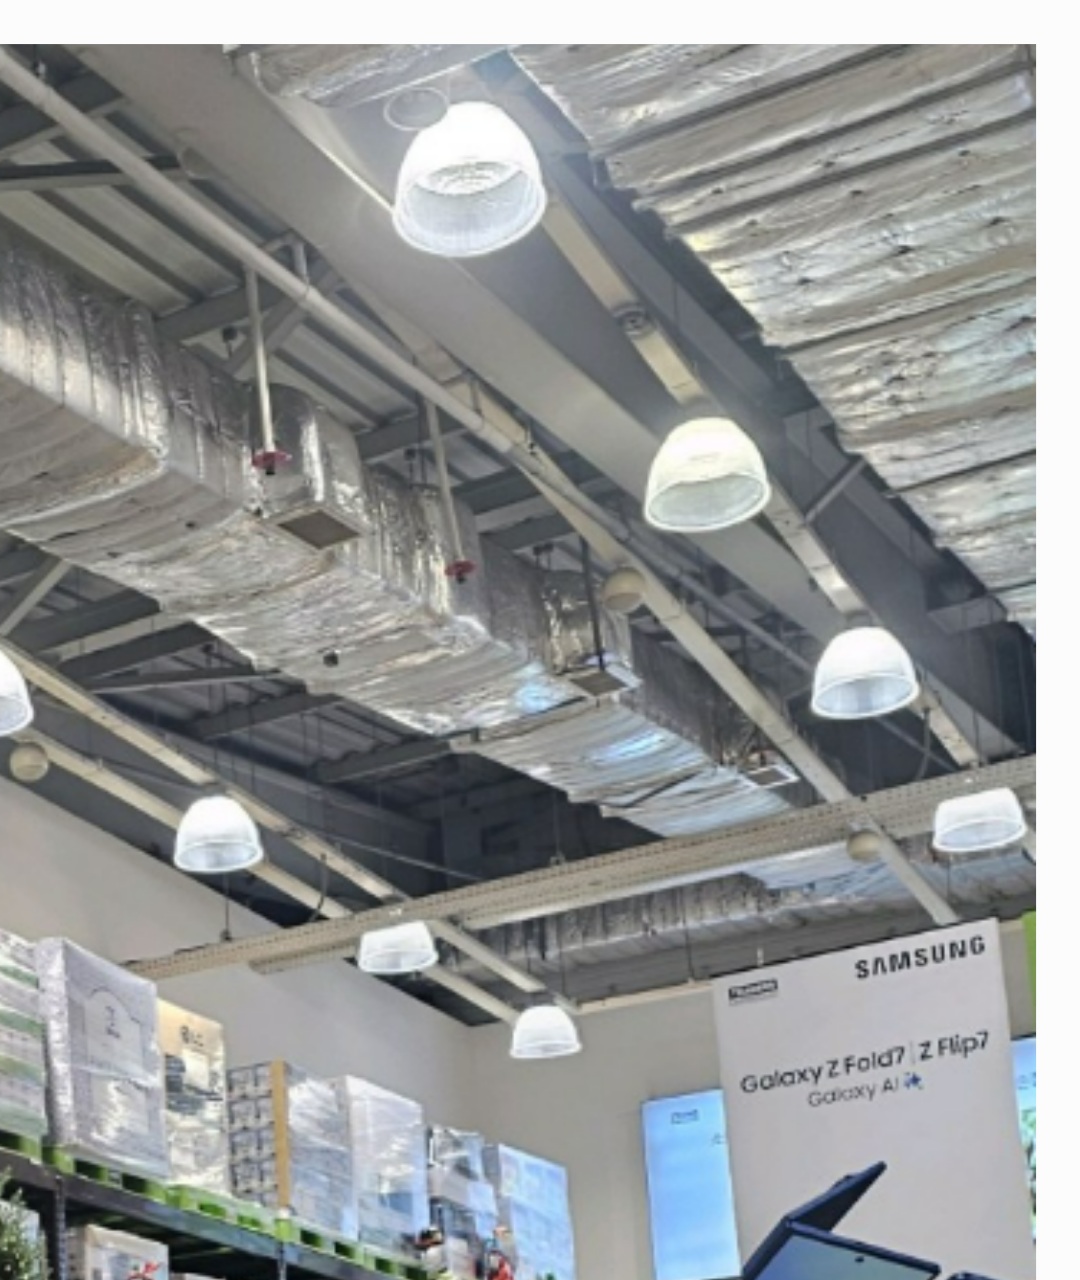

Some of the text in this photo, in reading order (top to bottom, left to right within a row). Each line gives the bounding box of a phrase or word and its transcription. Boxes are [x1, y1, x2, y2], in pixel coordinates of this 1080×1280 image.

[854, 934, 987, 980] SAMSUNG
[739, 1030, 990, 1095] Galaxy Z Fold7 Z Flip7
[806, 1077, 900, 1108] Galaxy AI
